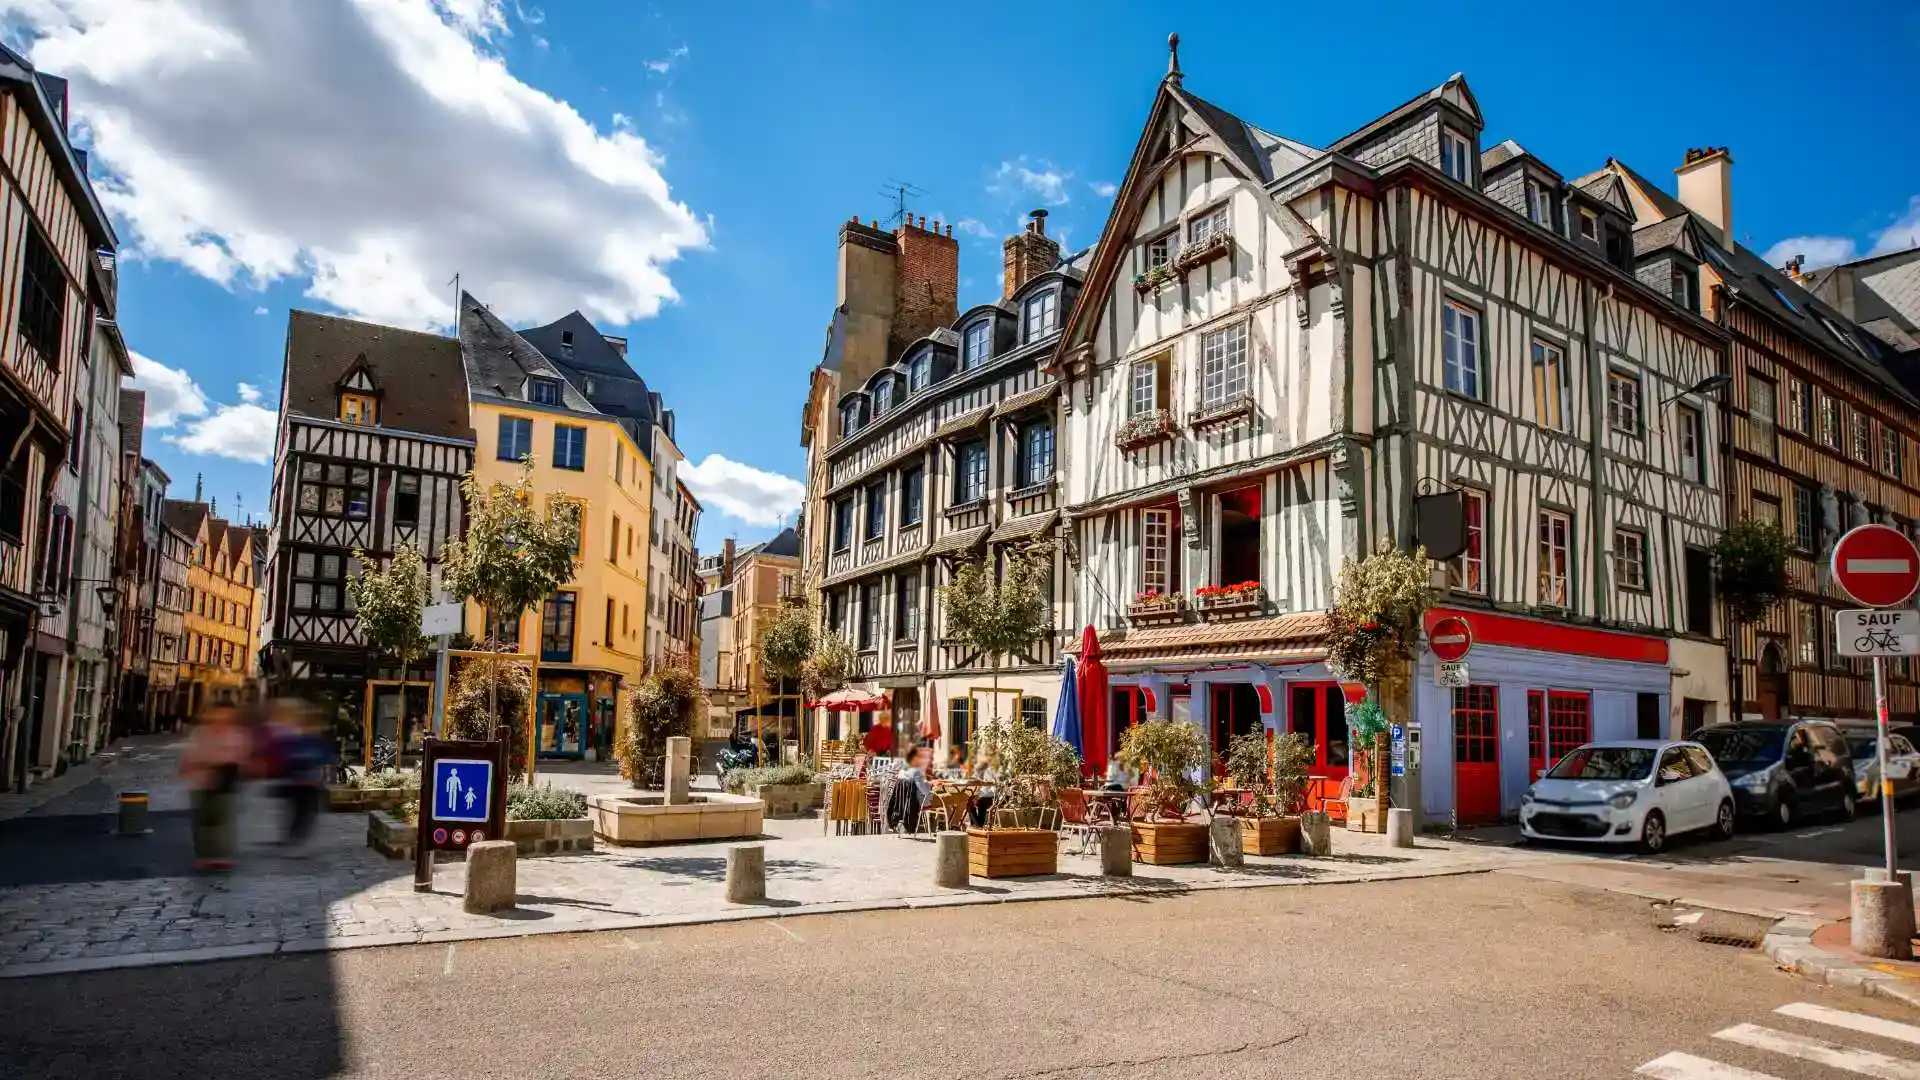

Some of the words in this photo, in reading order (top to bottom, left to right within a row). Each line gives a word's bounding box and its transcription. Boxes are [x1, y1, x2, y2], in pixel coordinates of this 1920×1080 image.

[1857, 613, 1901, 626] SAUF
[1440, 664, 1461, 672] SAUF
[1393, 728, 1401, 739] P
